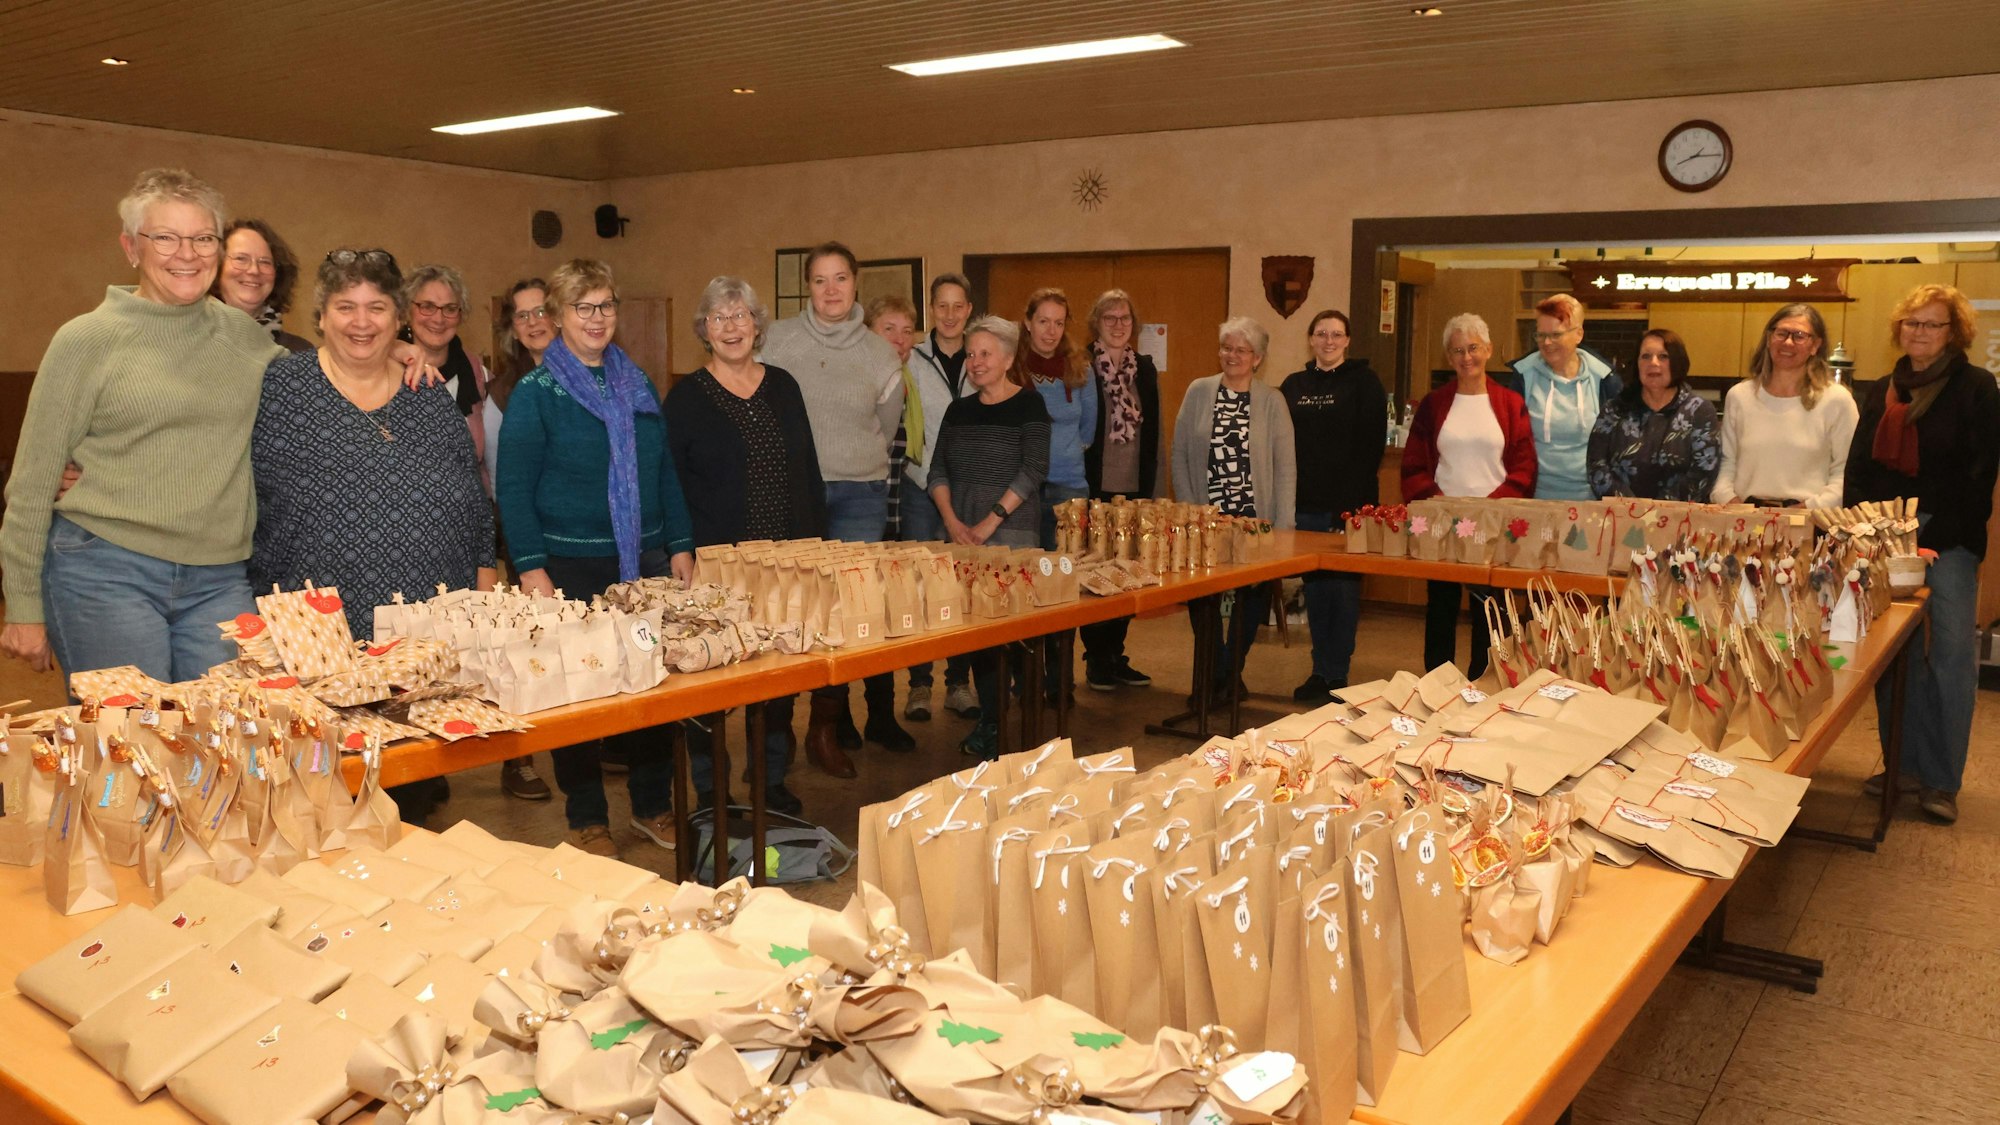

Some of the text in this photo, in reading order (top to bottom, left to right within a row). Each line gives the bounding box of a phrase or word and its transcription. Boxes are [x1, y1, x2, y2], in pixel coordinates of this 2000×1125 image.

[1616, 272, 1791, 292] Erzquell Pils
[1567, 506, 1579, 521] 3
[1656, 515, 1669, 529] 3
[1733, 518, 1746, 533] 3
[637, 627, 648, 641] 17
[1317, 826, 1325, 839] 11
[1422, 845, 1431, 858] 11
[188, 916, 207, 929] 13
[1239, 911, 1247, 926] 11
[1327, 929, 1335, 944] 11
[87, 955, 112, 970] 13
[146, 1005, 176, 1017] 13
[251, 1057, 280, 1071] 13
[1251, 1066, 1268, 1081] 12
